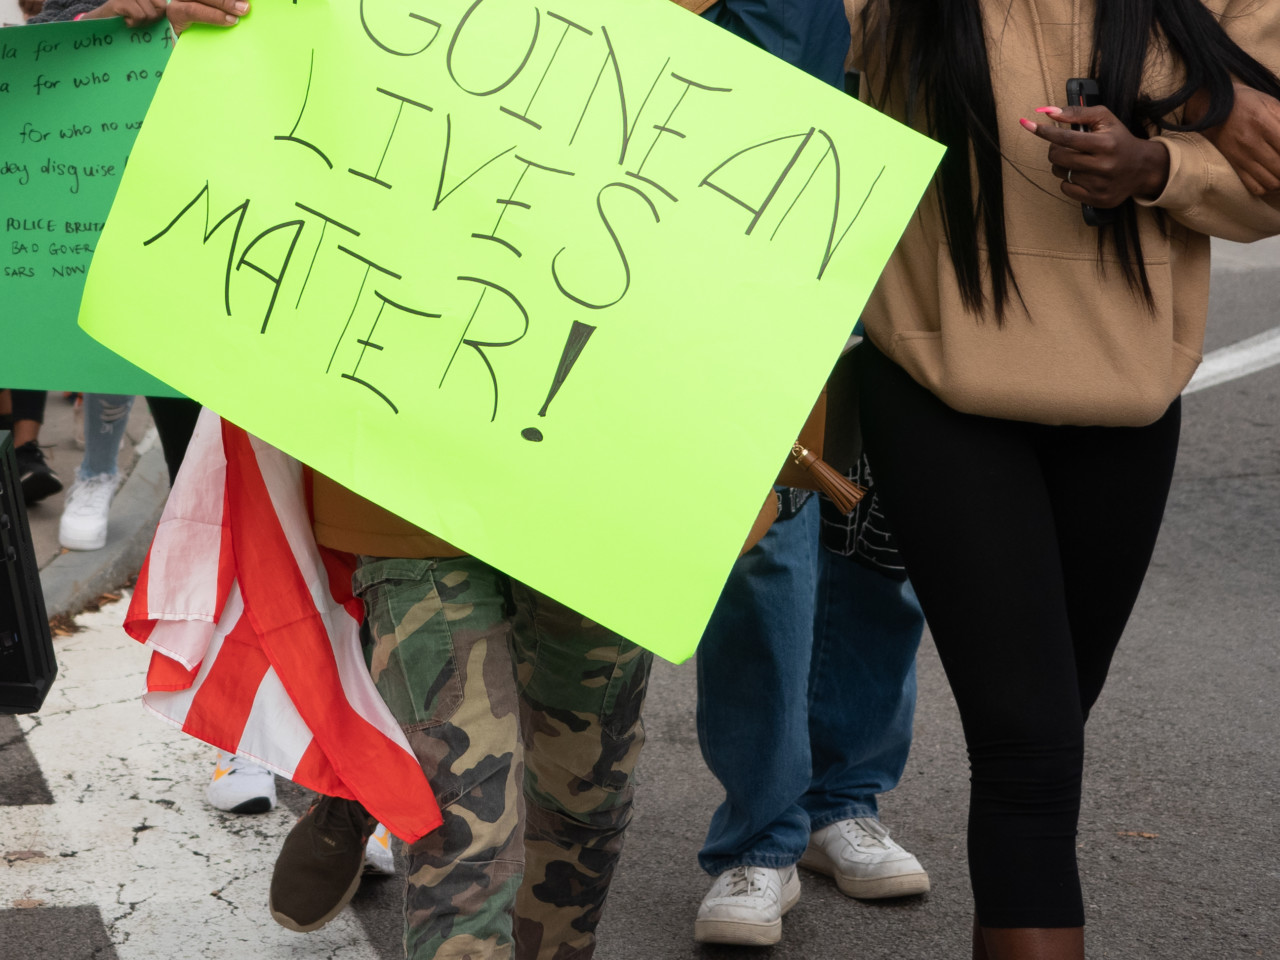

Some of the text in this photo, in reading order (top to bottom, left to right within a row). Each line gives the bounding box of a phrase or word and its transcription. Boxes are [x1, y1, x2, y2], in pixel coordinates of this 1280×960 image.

[33, 41, 61, 62] for
[73, 32, 114, 49] who
[129, 31, 152, 45] no
[33, 74, 61, 96] for
[73, 71, 111, 89] who
[126, 69, 149, 82] no
[19, 122, 52, 144] for
[59, 123, 92, 140] who
[101, 121, 119, 133] no
[40, 157, 116, 194] disguise
[273, 48, 663, 311] LIVES
[6, 217, 57, 232] POLICE
[11, 240, 40, 255] BAD
[48, 242, 95, 256] GOVER
[3, 266, 35, 278] SARS
[51, 264, 87, 278] NOW
[142, 179, 598, 444] MATTER!
